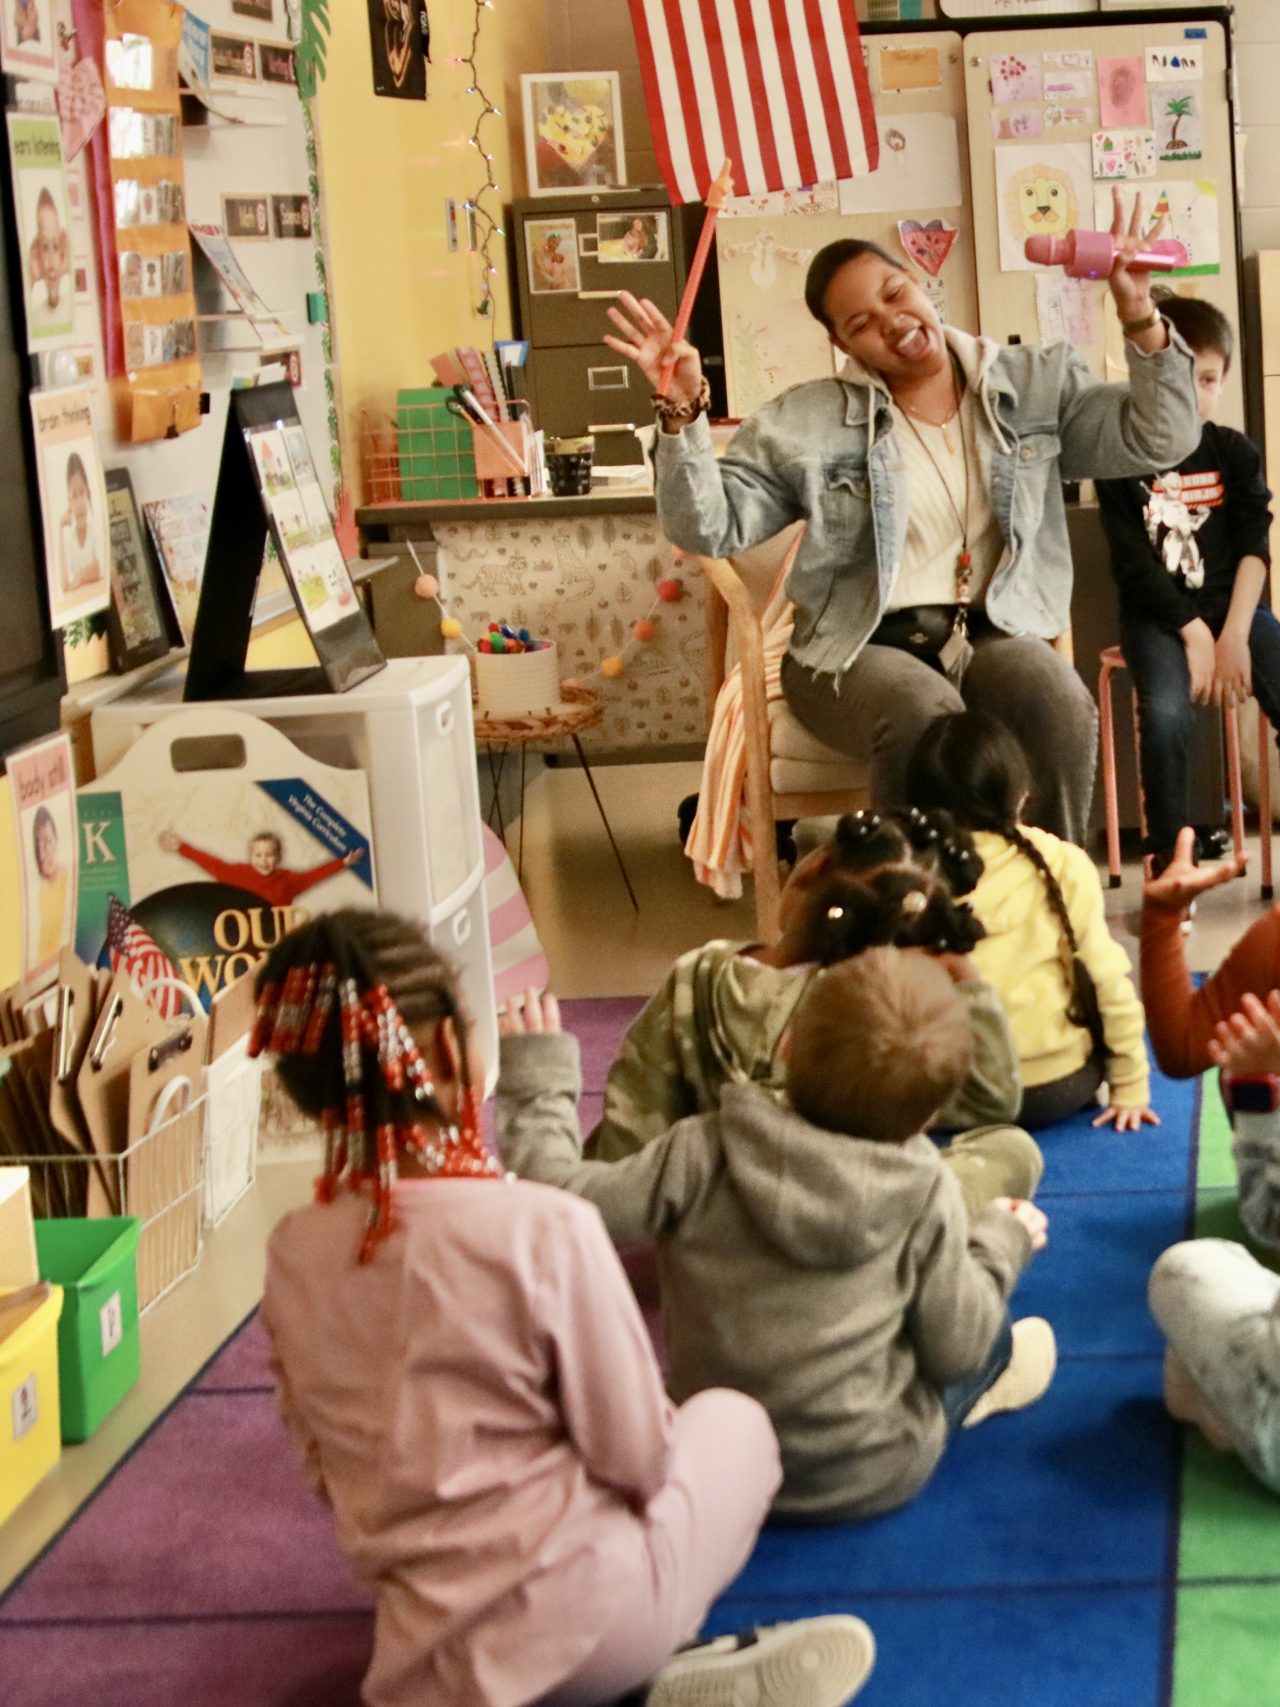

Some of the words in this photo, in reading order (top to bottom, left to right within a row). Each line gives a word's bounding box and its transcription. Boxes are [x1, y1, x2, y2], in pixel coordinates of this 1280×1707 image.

[288, 794, 314, 822] Virginia
[303, 794, 317, 809] The
[315, 806, 347, 838] Complete
[83, 821, 116, 864] K
